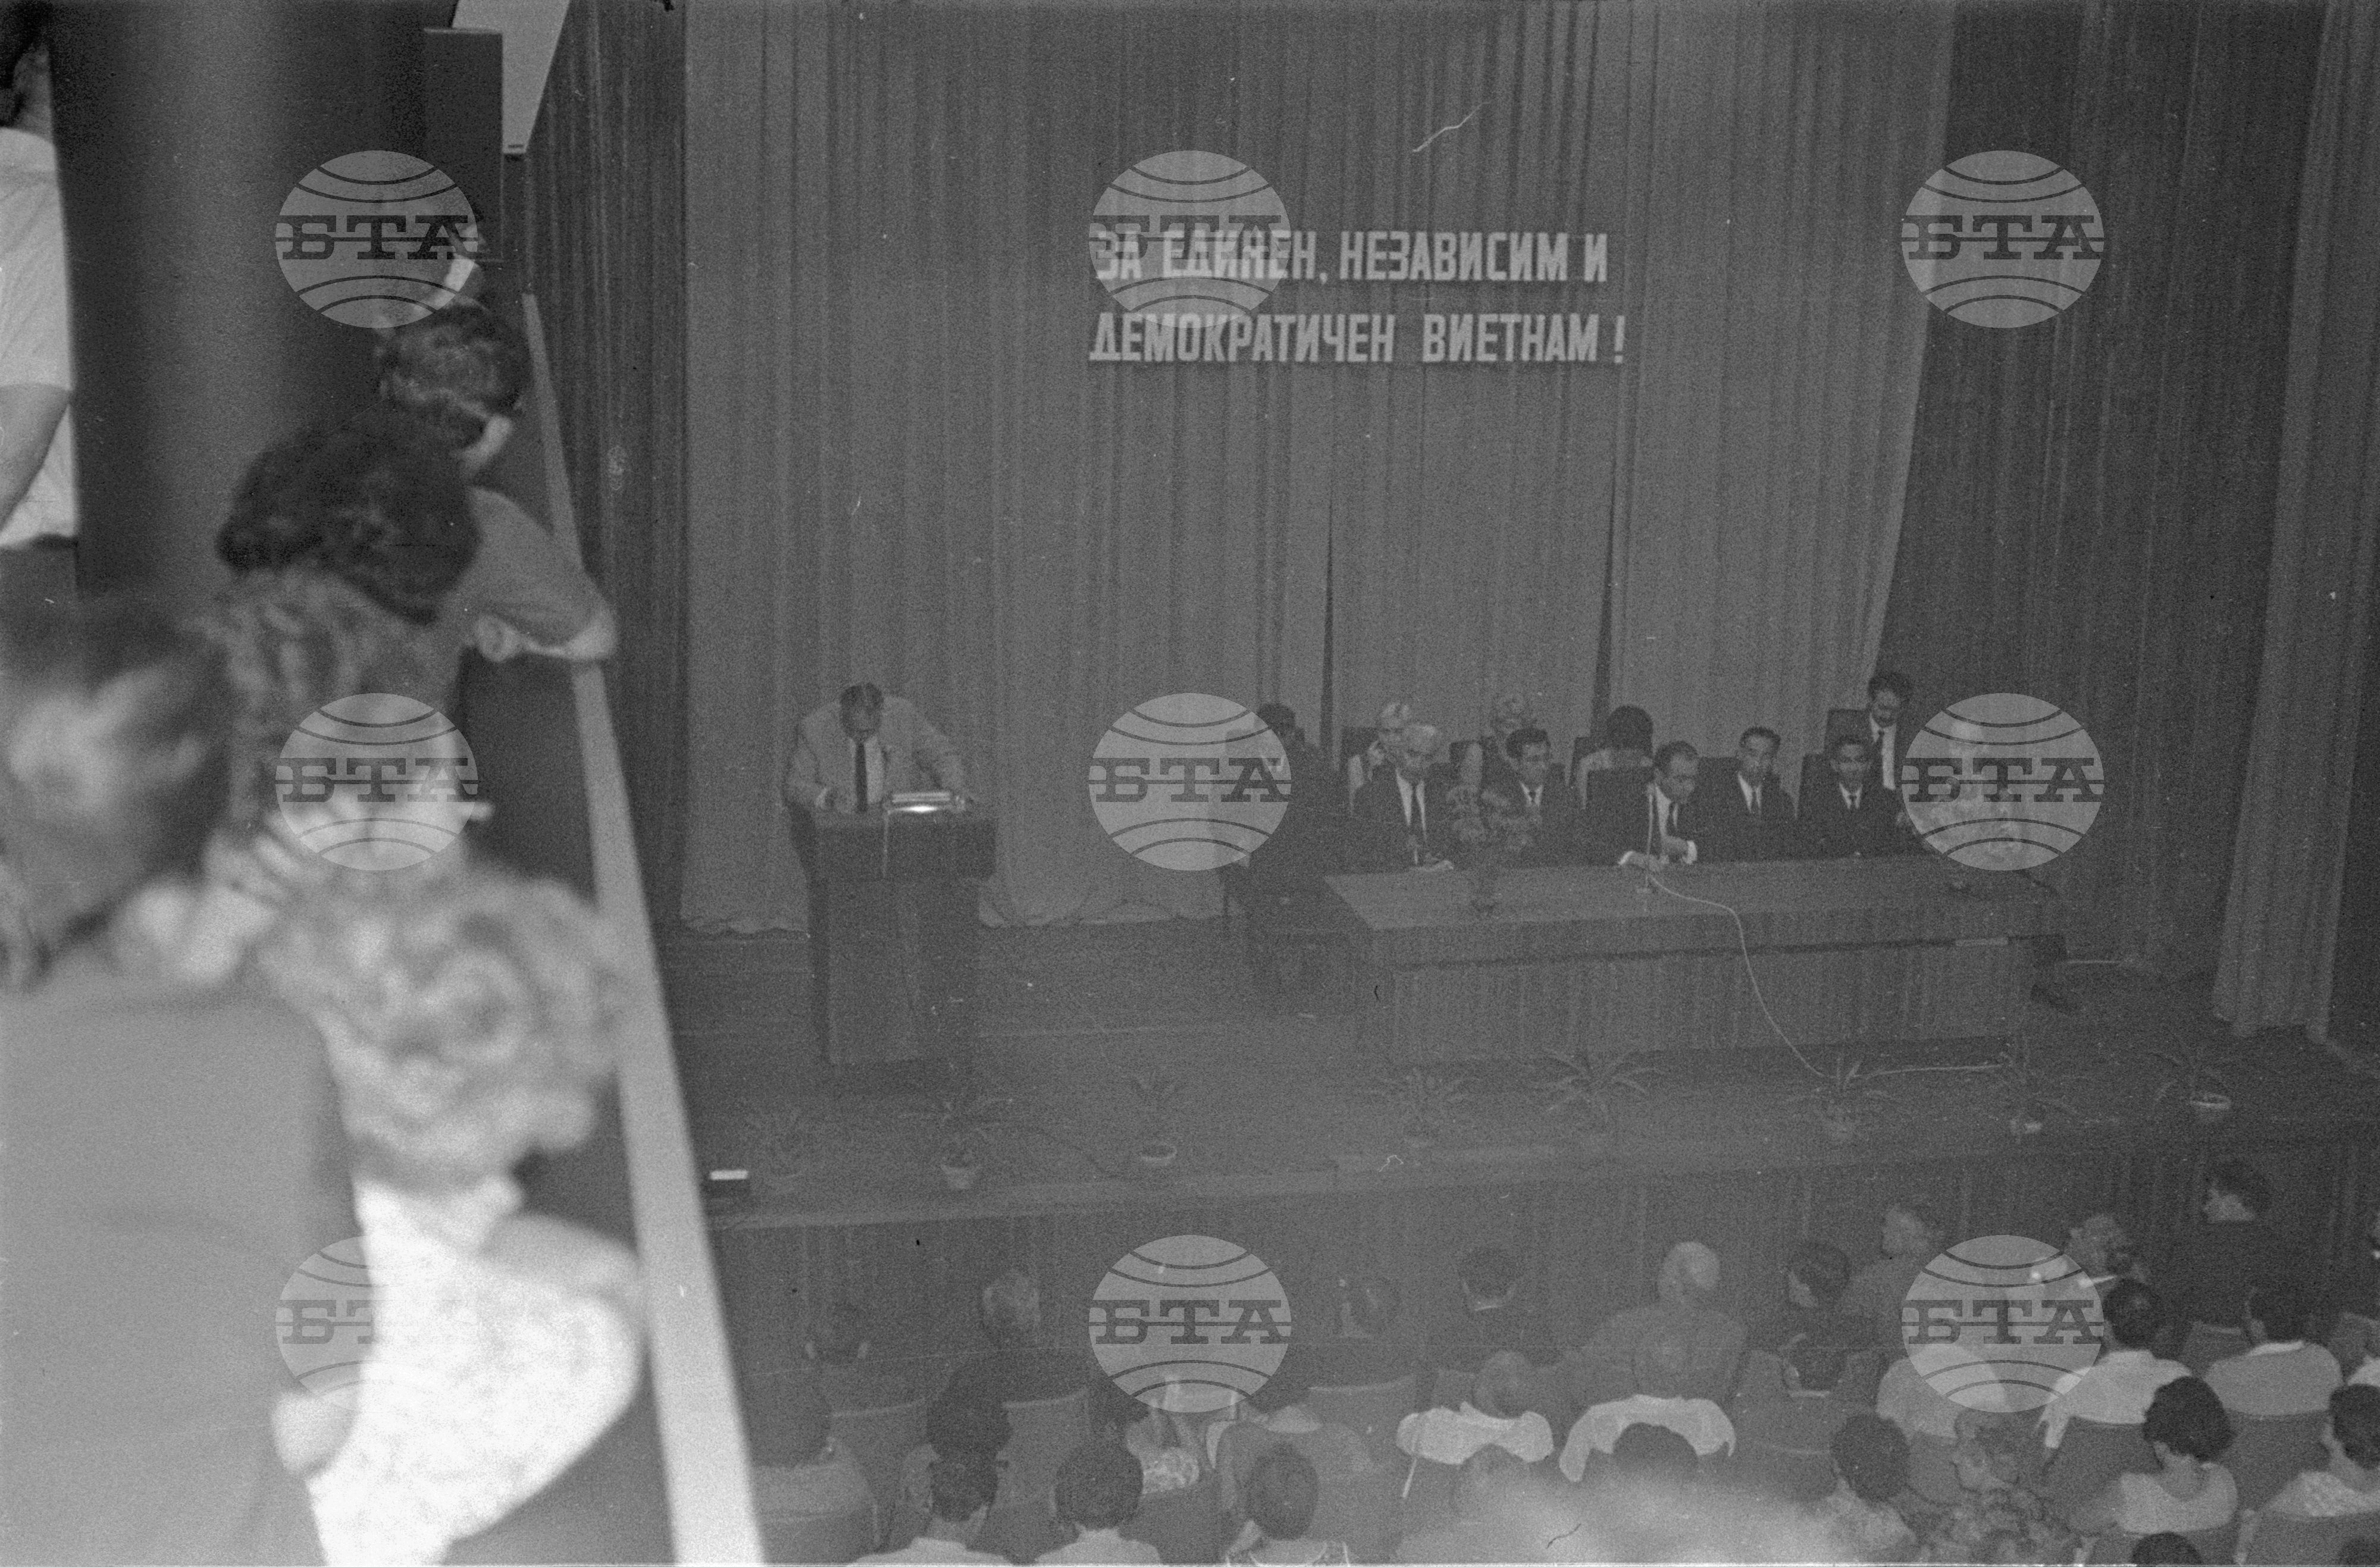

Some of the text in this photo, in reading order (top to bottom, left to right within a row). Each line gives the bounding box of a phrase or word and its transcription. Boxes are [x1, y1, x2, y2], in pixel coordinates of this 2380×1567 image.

[1097, 230, 1142, 280] ЗА
[1340, 231, 1568, 281] НЕЗАВИСИМ
[1584, 233, 1608, 282] И
[1089, 312, 1395, 362] ДЕМОКРАТИЧЕН
